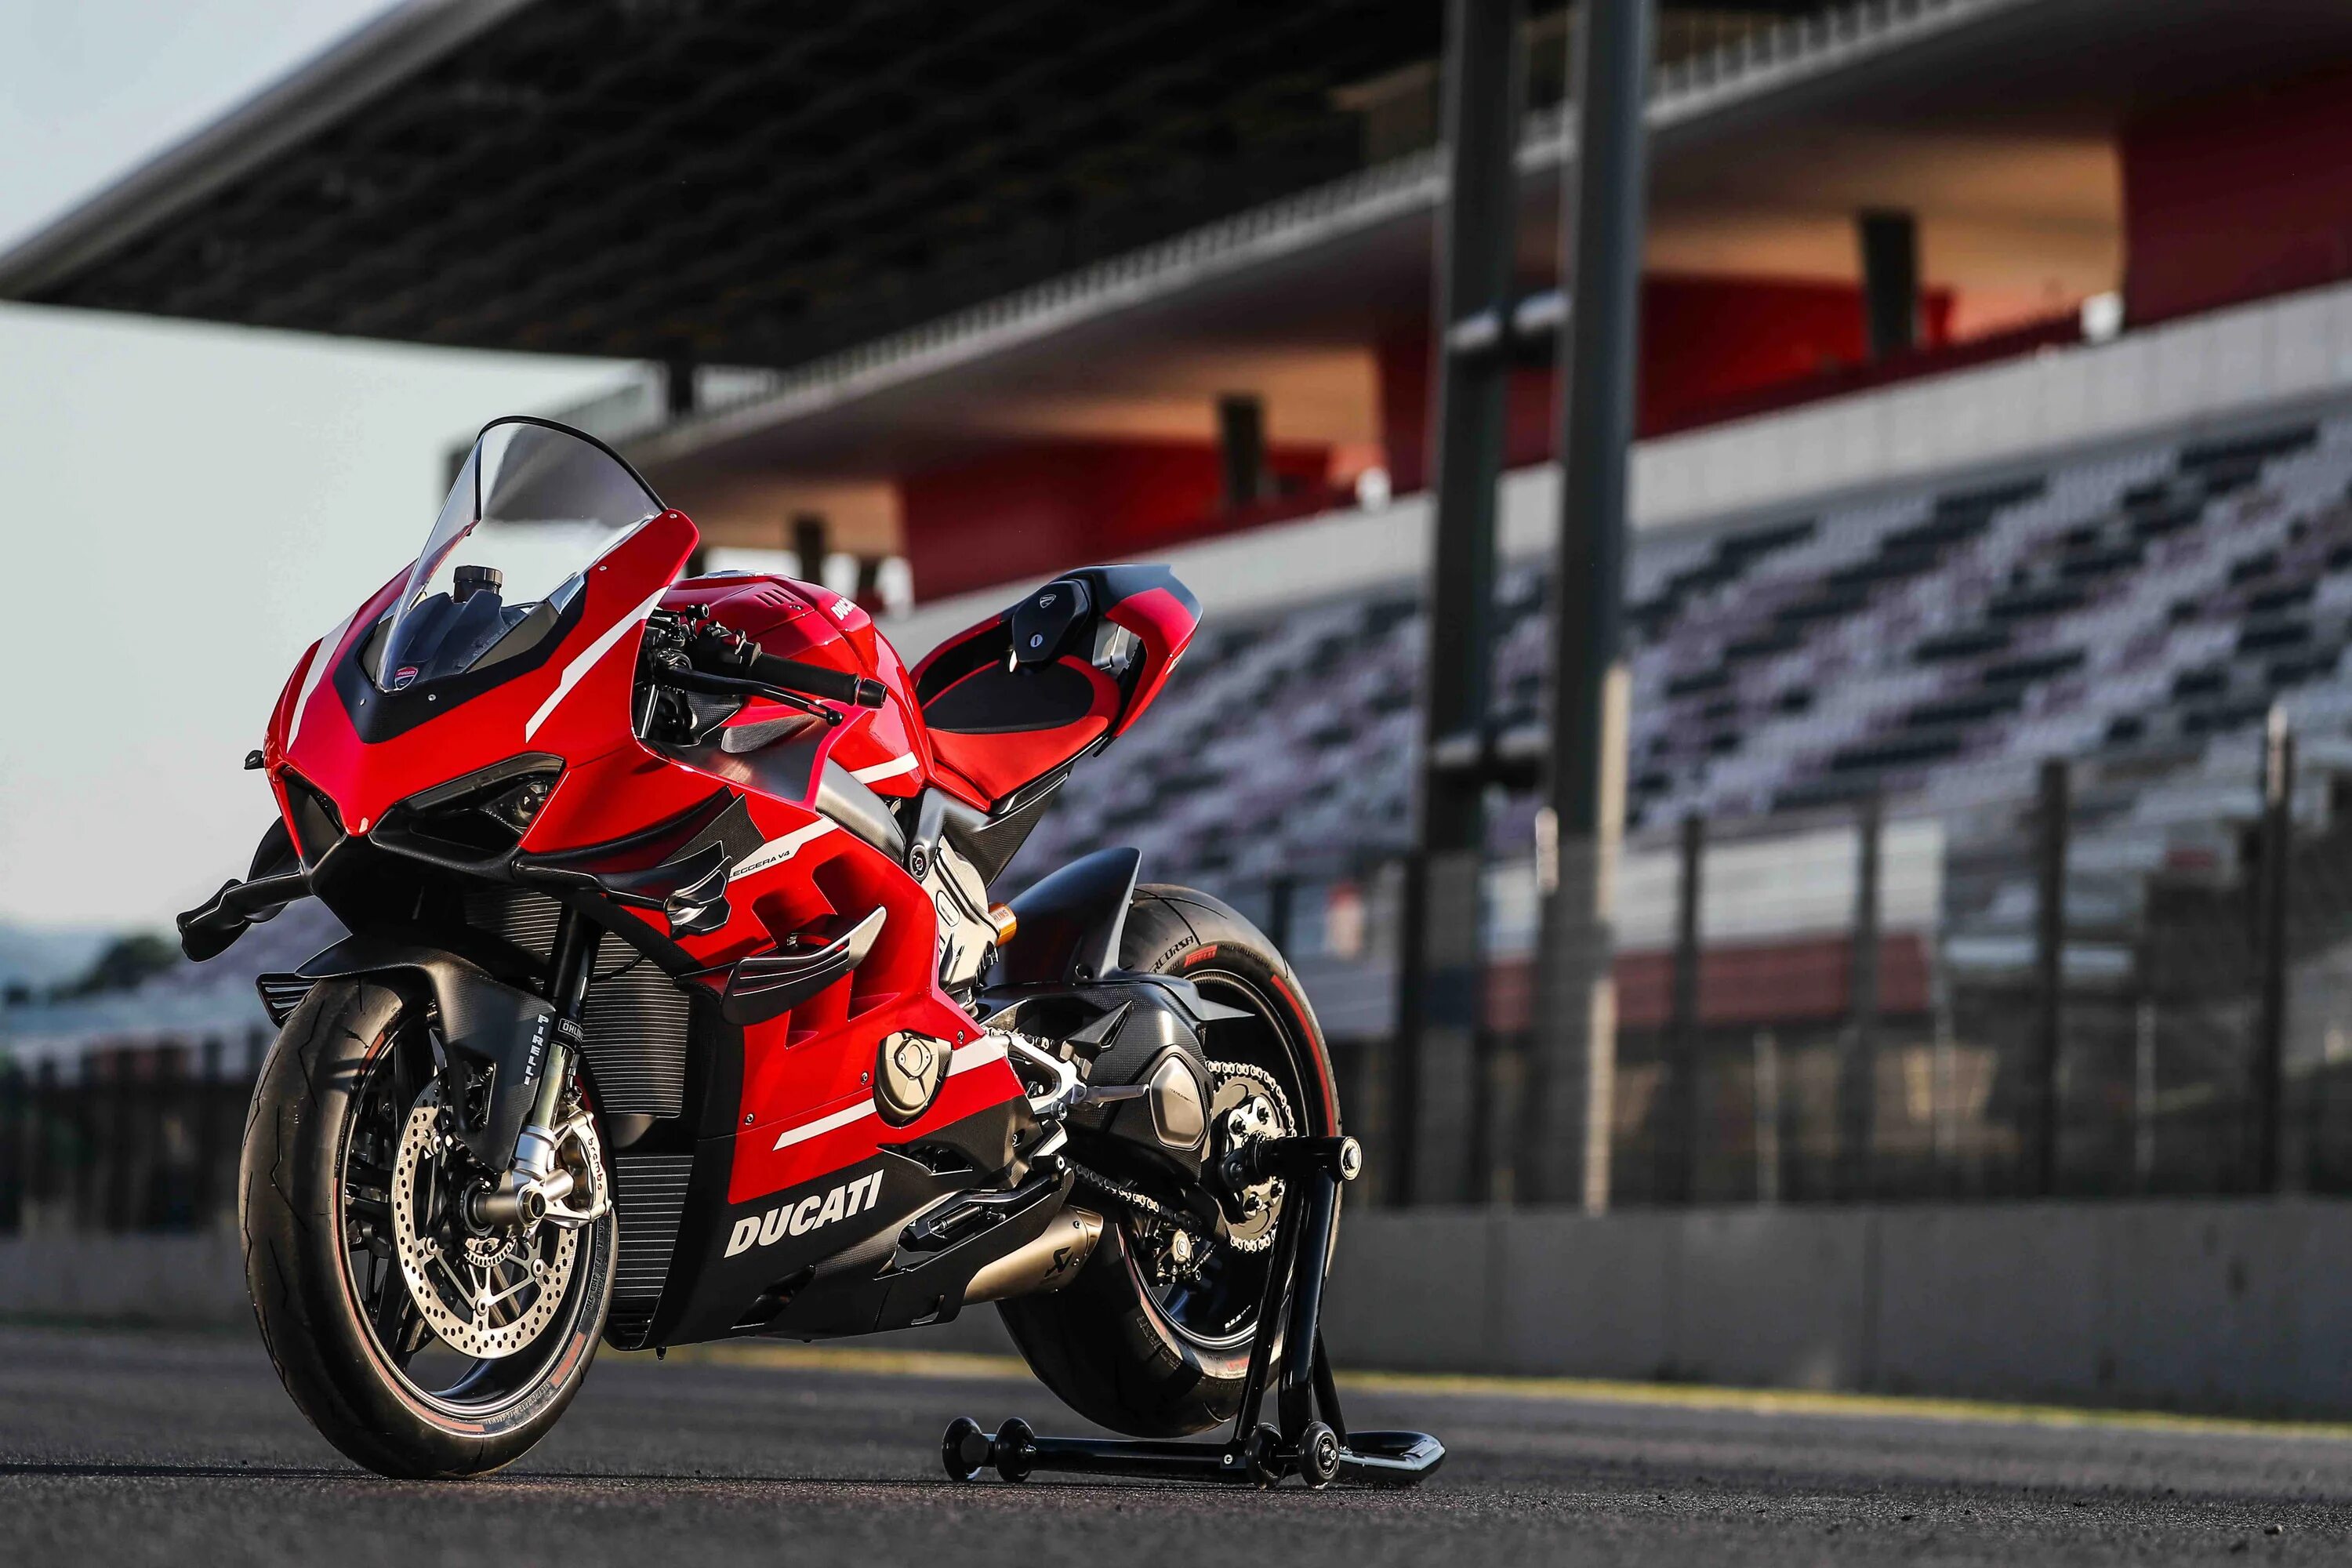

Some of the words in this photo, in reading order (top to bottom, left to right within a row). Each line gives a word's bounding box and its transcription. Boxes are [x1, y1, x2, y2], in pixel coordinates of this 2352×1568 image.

[730, 857, 776, 877] EGGERA
[524, 1014, 549, 1086] PIRELLI
[588, 1138, 603, 1190] brembo
[724, 1169, 884, 1258] DUCATI
